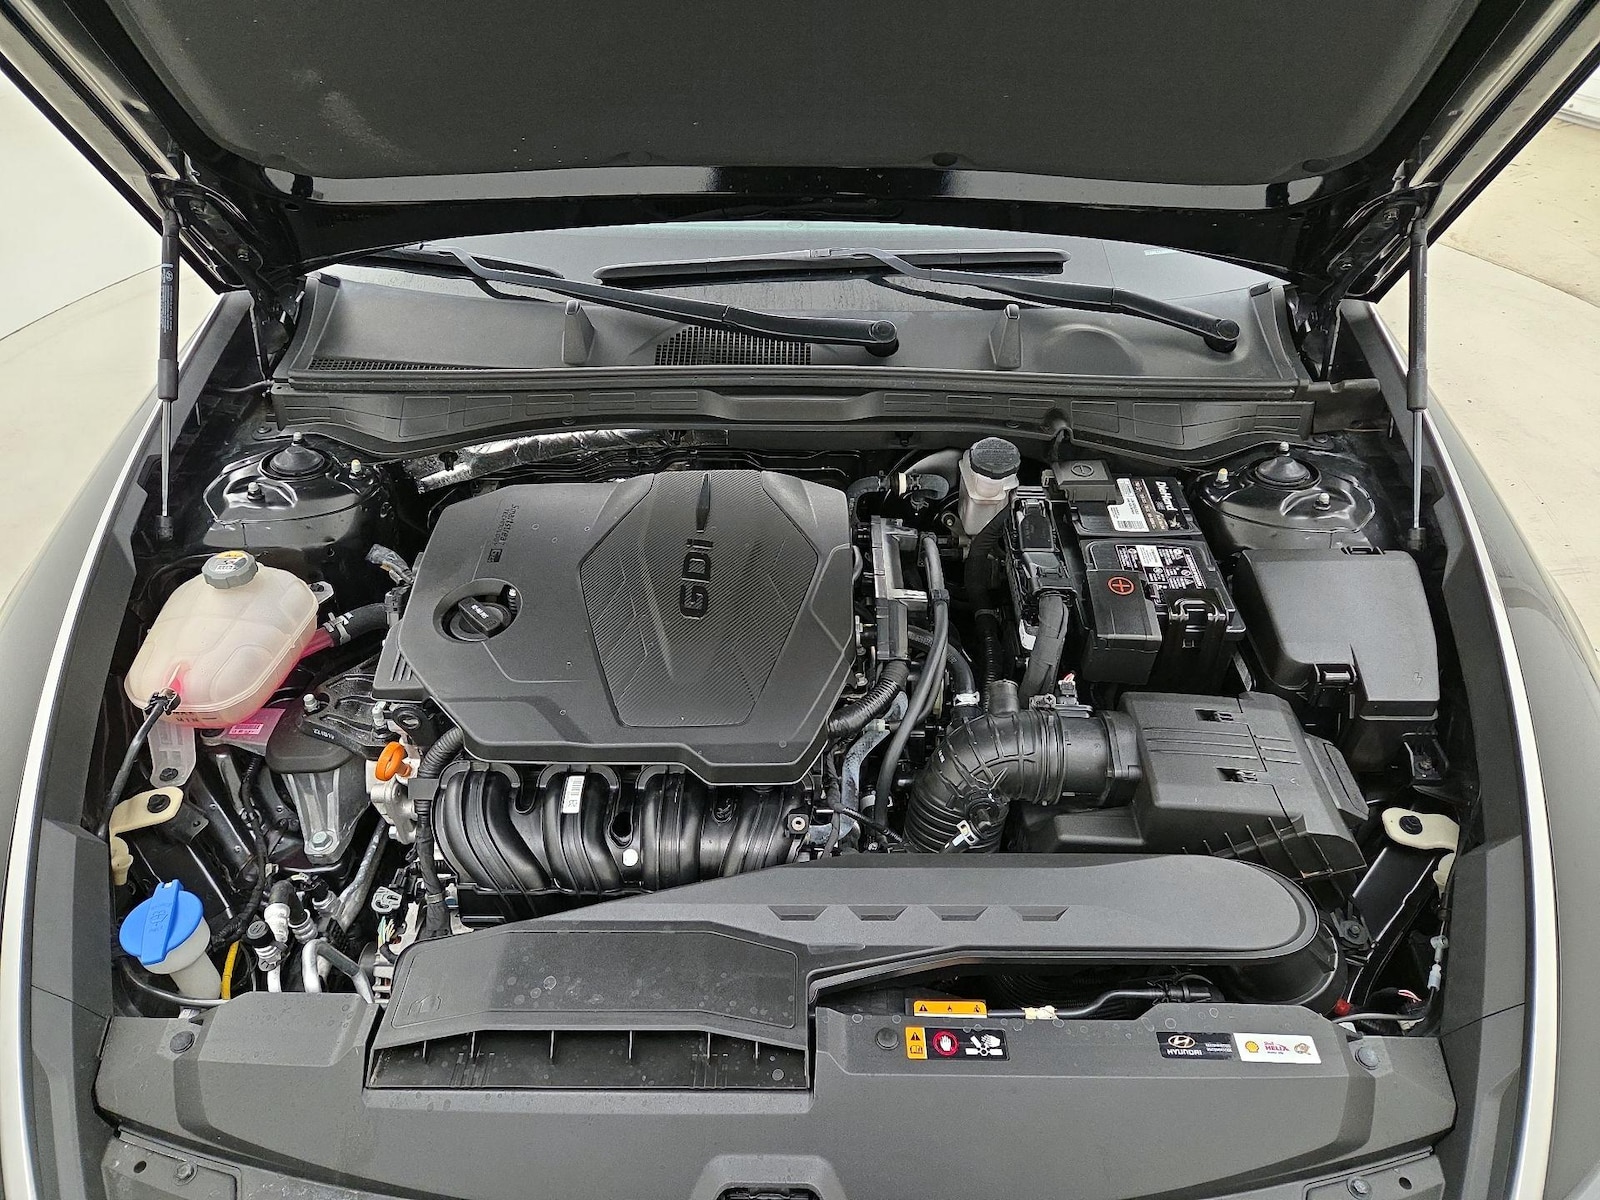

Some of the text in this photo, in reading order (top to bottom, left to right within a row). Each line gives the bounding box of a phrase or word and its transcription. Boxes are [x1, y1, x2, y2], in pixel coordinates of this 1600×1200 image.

[1155, 481, 1178, 511] DieHard
[1166, 1048, 1203, 1056] HYUNDAI
[1264, 1044, 1290, 1052] HELIX
